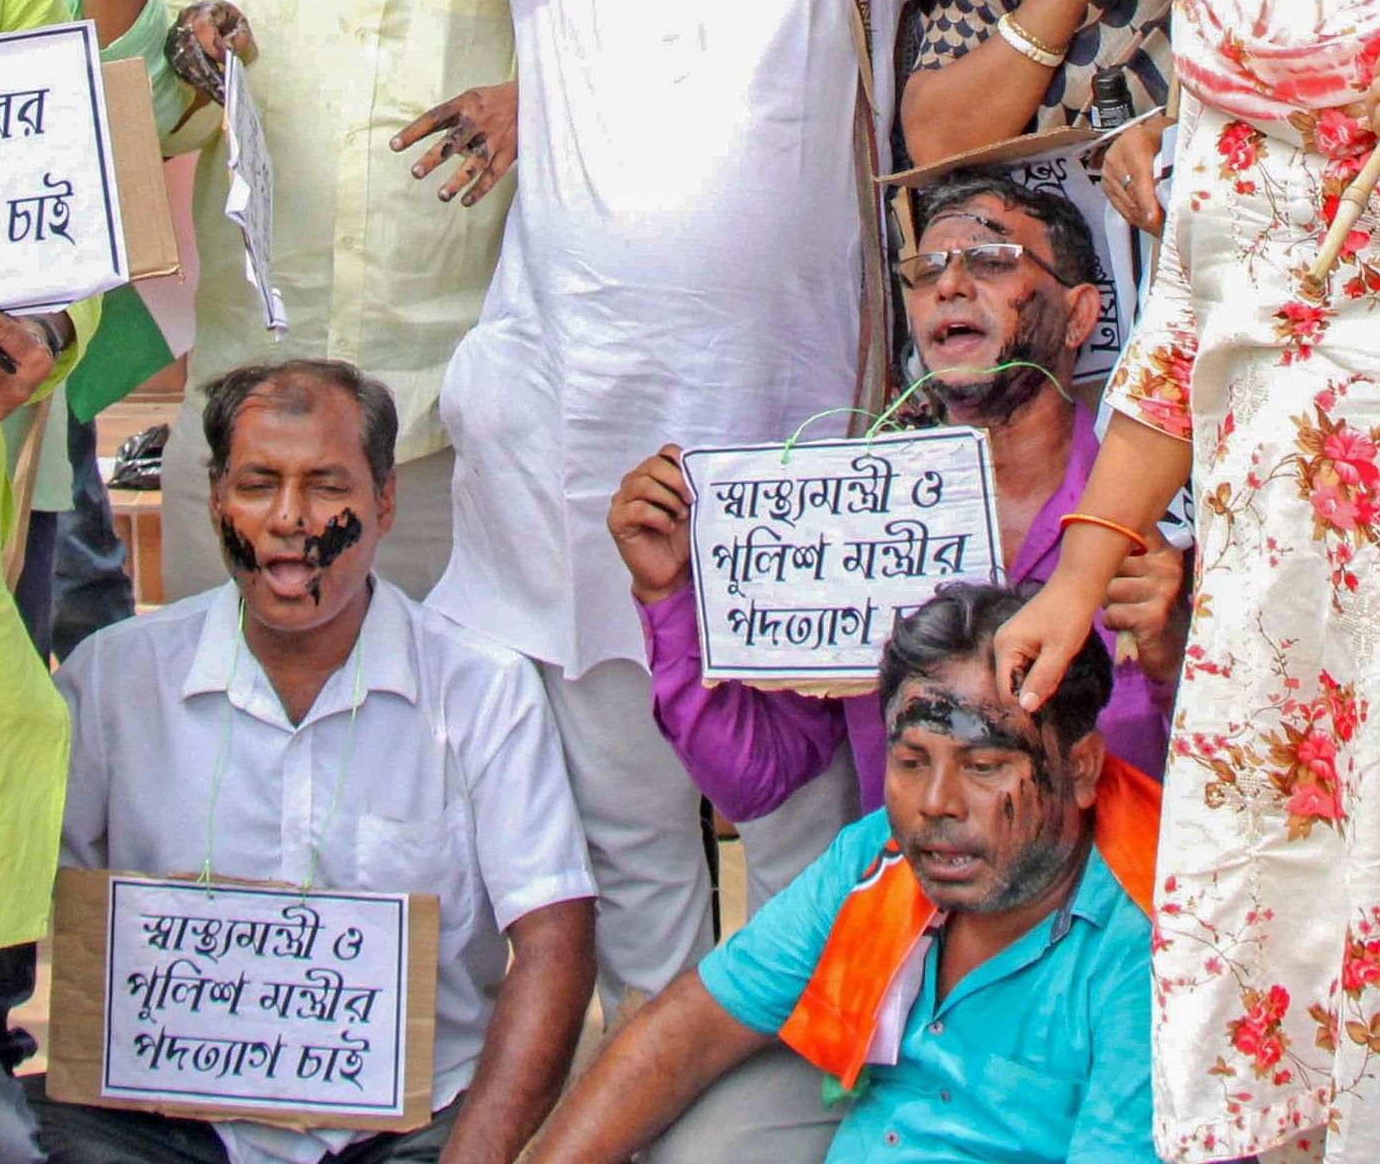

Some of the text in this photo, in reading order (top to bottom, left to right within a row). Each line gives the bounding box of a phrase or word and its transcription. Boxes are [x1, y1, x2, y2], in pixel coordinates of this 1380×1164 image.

[7, 173, 77, 245] চাই
[710, 455, 944, 527] স্বাস্থ্যমন্ত্রী ও
[712, 520, 973, 597] পুলিশ মন্ত্রীর
[727, 597, 878, 650] পদত্যাগ
[140, 904, 364, 963] স্বাস্থ্যমন্ত্রী ও
[126, 958, 383, 1024] পুলিশ মন্ত্রীর
[133, 1025, 370, 1091] পদত্যাগ চাই
